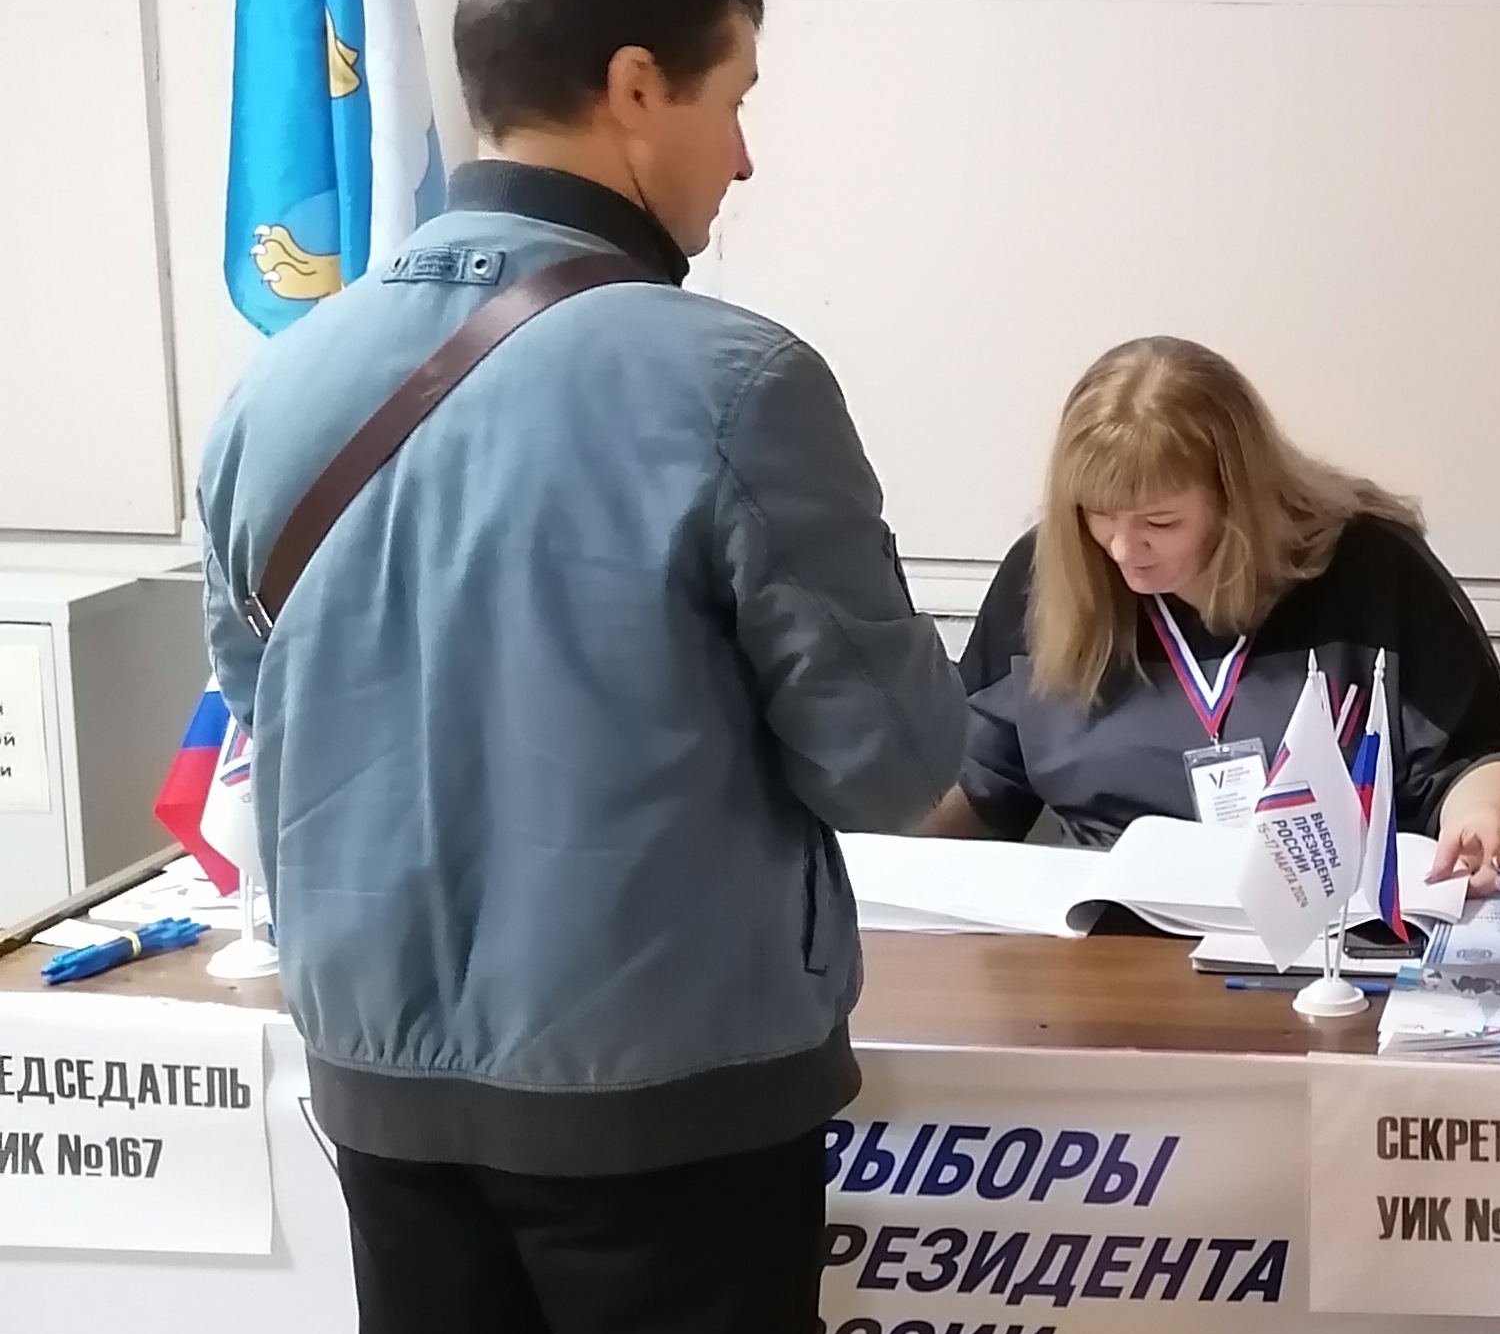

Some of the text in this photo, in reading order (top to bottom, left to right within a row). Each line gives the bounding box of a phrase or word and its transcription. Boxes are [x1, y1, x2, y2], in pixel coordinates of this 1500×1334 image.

[1270, 851, 1298, 885] МАРТА
[1271, 819, 1311, 874] РОССИИ
[1291, 815, 1335, 899] ПРЕЗИДЕНТА
[1310, 811, 1341, 869] ВЫБОРЫ
[0, 1054, 251, 1111] ЕДСЕДАТЕЛЬ
[0, 1131, 163, 1179] ИК №167
[824, 1119, 1181, 1207] ВЫБОРЫ
[1376, 1195, 1453, 1242] УИК
[824, 1223, 1290, 1307] РЕЗИДЕНТА
